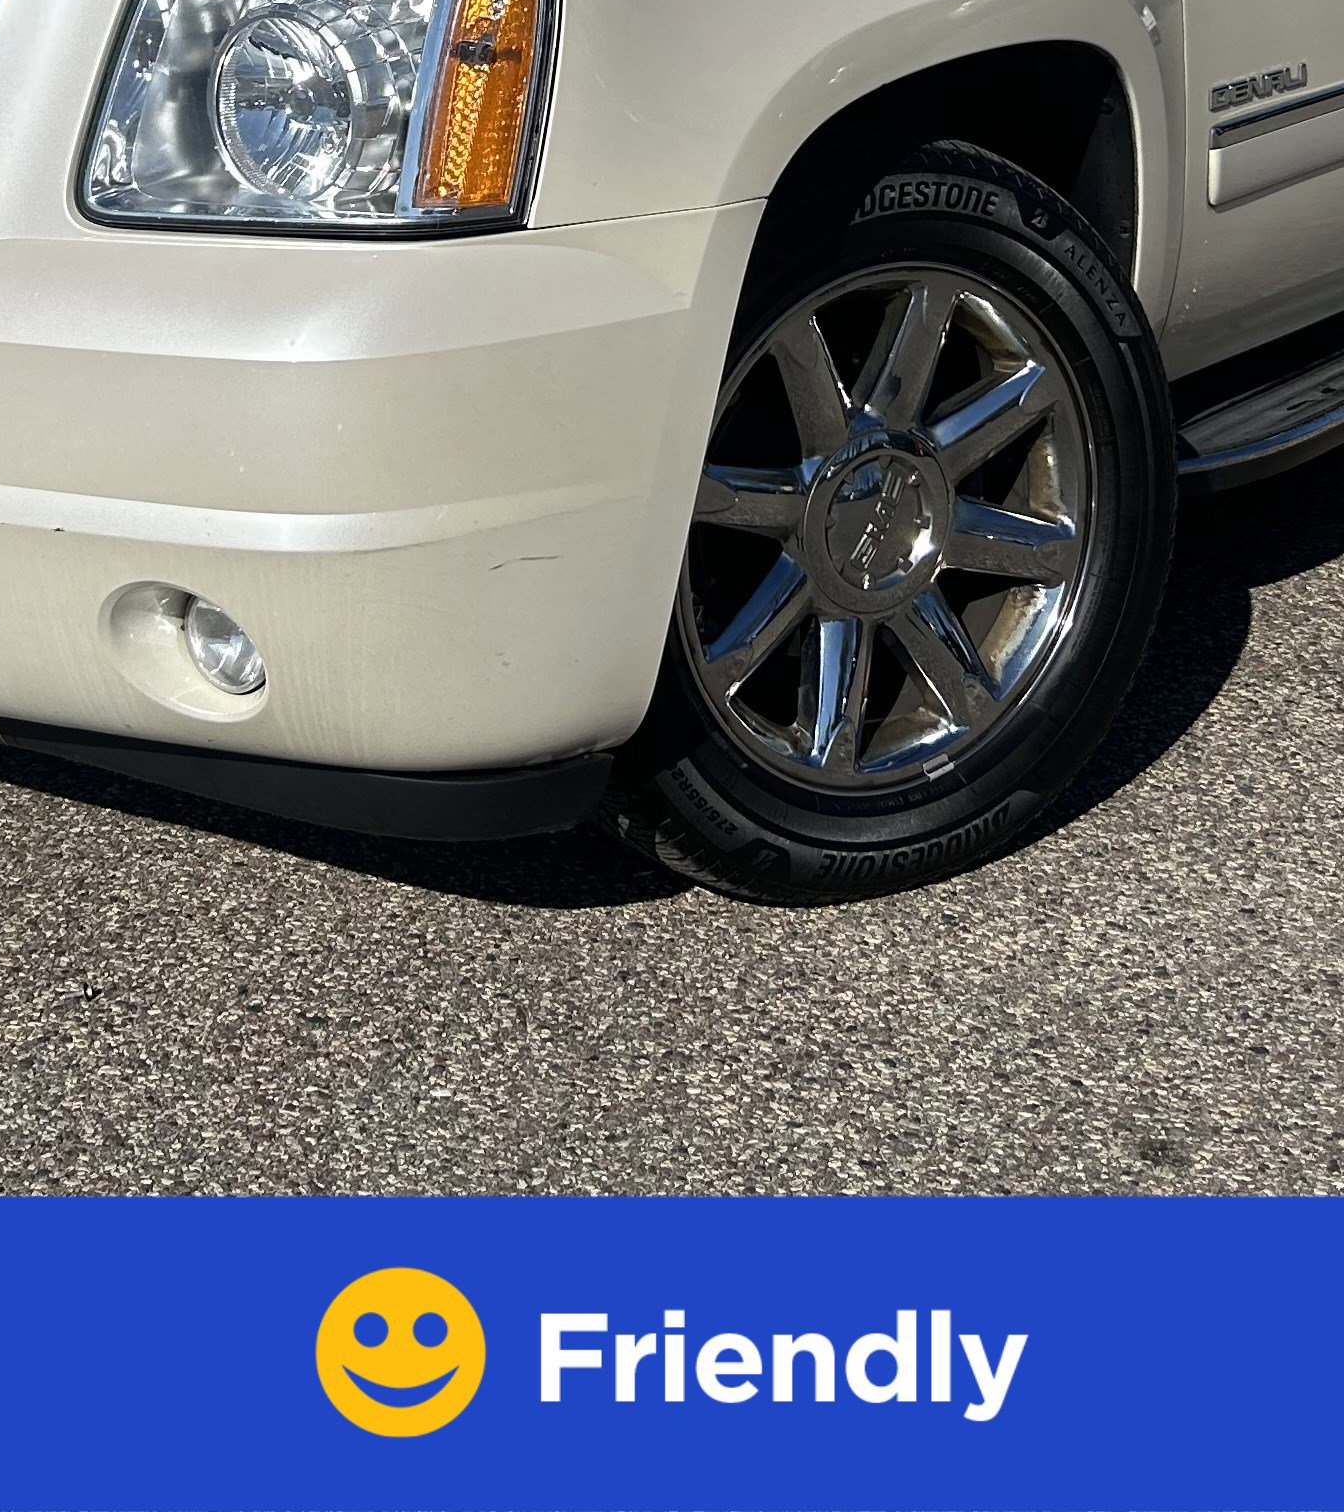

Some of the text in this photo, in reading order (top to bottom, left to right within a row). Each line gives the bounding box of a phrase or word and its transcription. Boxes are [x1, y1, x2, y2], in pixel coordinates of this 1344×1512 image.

[1208, 61, 1308, 113] DENALI
[856, 180, 1001, 220] DGESTONE
[1063, 243, 1129, 329] ALENZA
[671, 766, 739, 836] 275/55R2
[816, 799, 1012, 881] BRIDGESTONE
